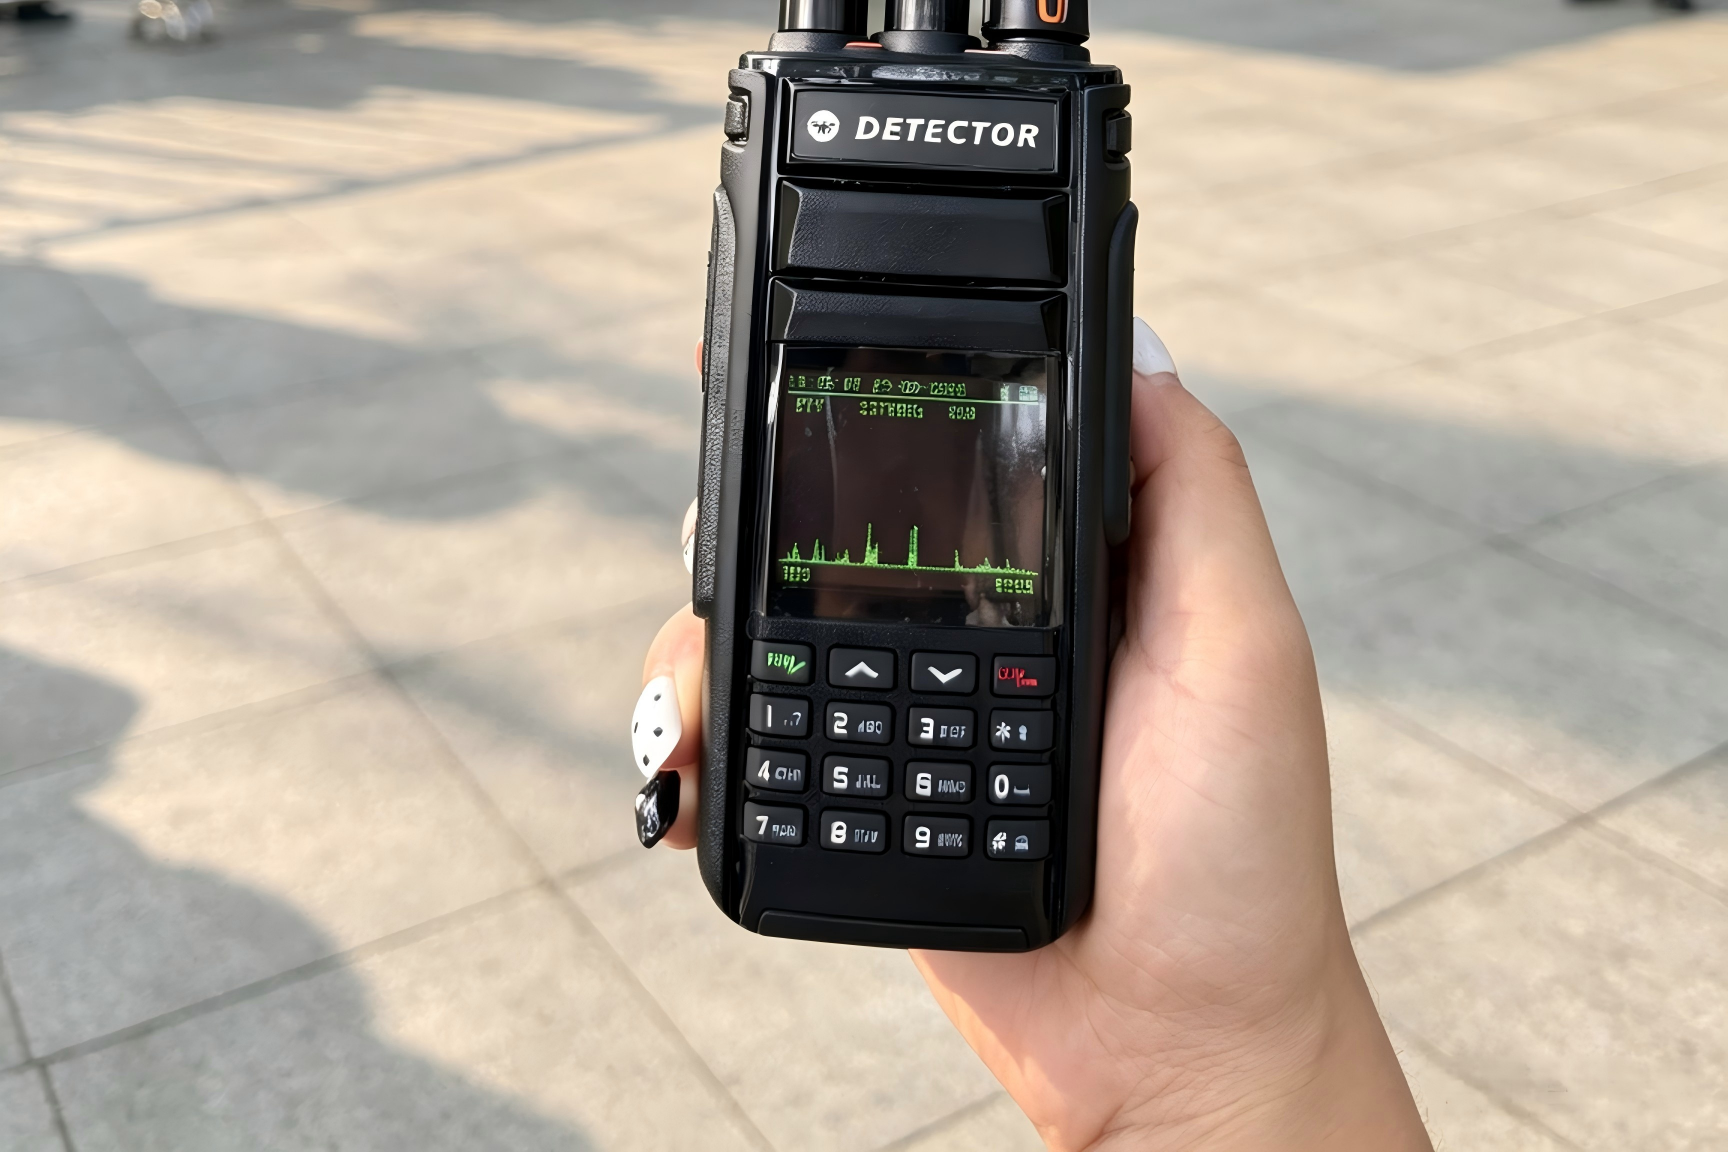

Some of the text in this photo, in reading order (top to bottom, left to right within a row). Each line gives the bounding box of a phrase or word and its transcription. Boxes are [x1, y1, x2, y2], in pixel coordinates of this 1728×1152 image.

[854, 115, 1040, 148] DETECTOR
[833, 711, 848, 734] 2
[919, 717, 935, 740] 3
[757, 760, 770, 782] 4
[833, 766, 849, 789] 5
[915, 772, 932, 797] 6
[994, 774, 1010, 799] 0
[755, 815, 769, 835] 7
[830, 821, 847, 844] 8
[915, 826, 931, 848] 9
